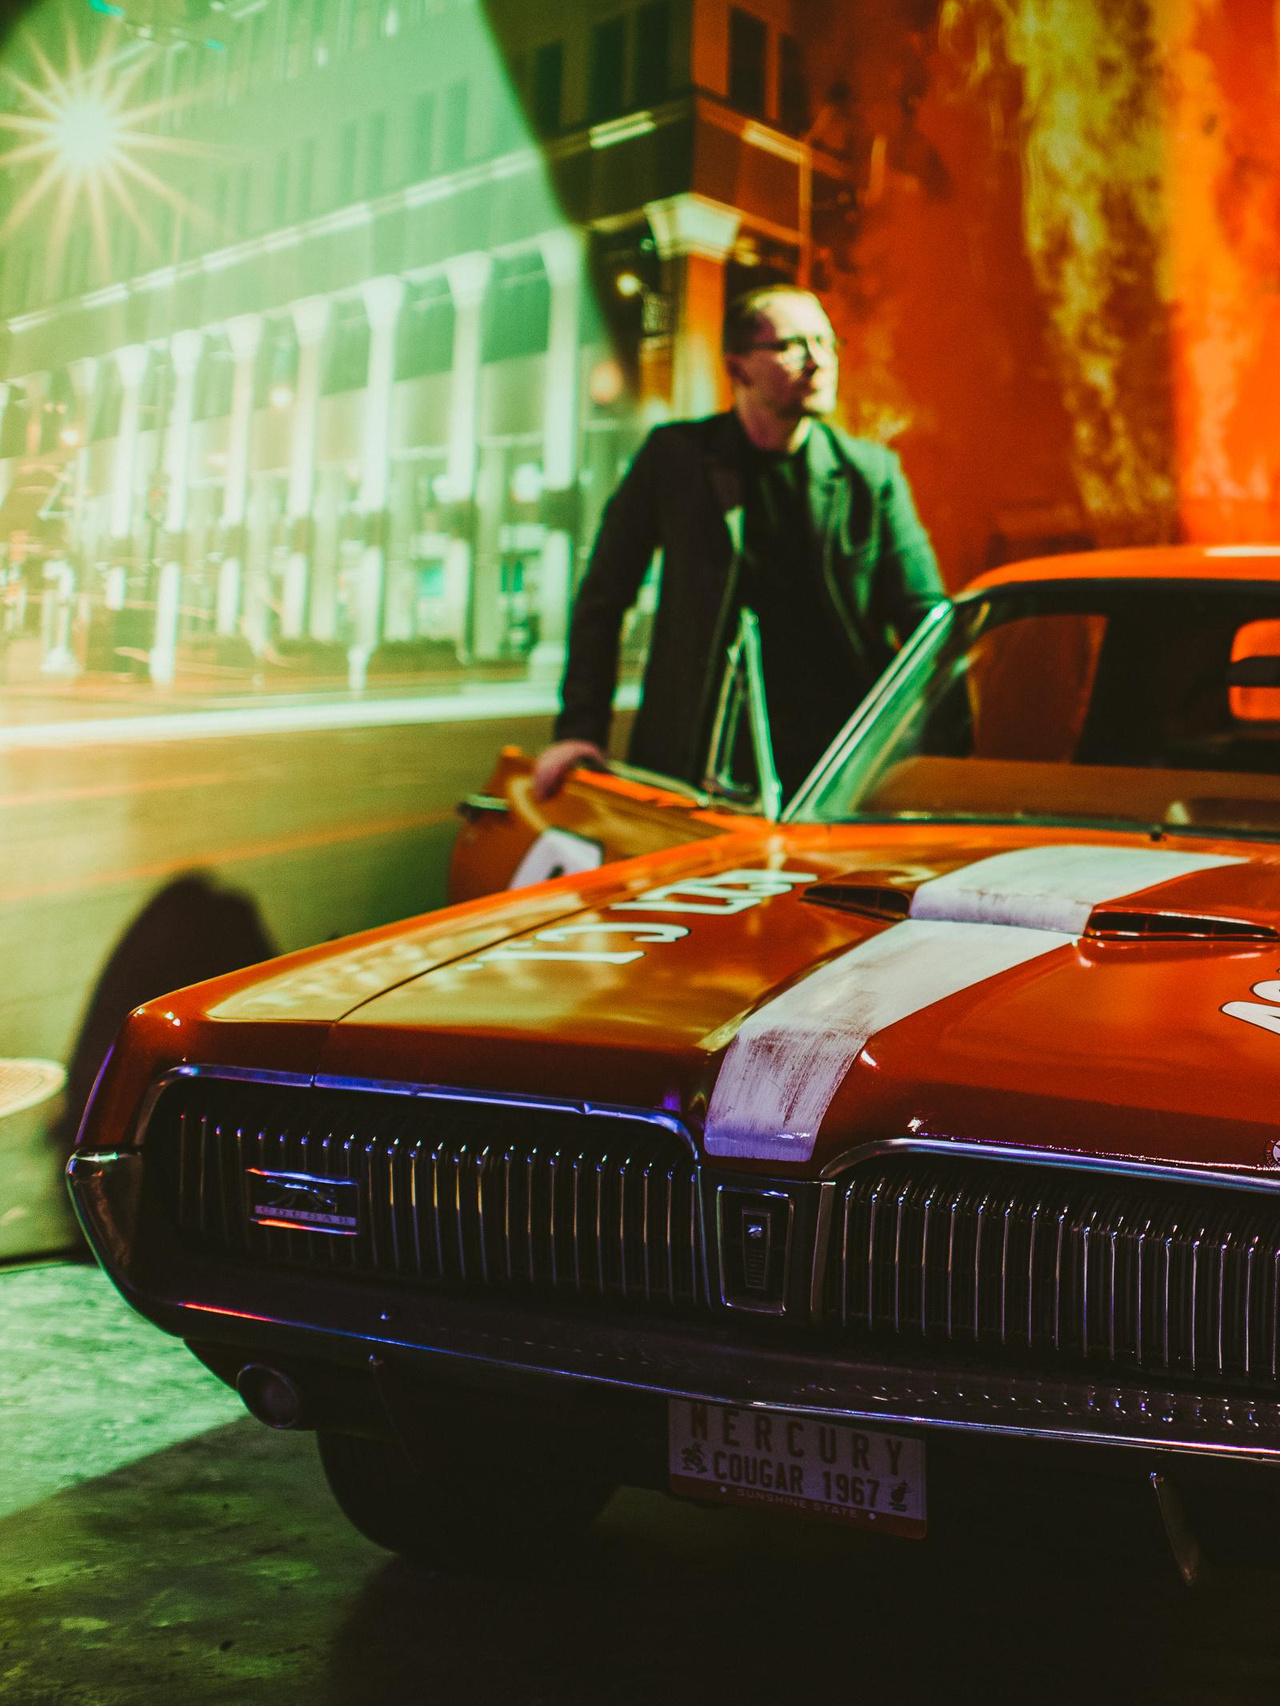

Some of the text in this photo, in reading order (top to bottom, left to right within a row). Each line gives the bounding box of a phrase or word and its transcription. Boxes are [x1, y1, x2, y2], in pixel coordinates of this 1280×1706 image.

[689, 1403, 903, 1476] MERCURY
[713, 1450, 880, 1508] COUGAR 1967
[736, 1487, 859, 1518] SUNSHINE STATE
